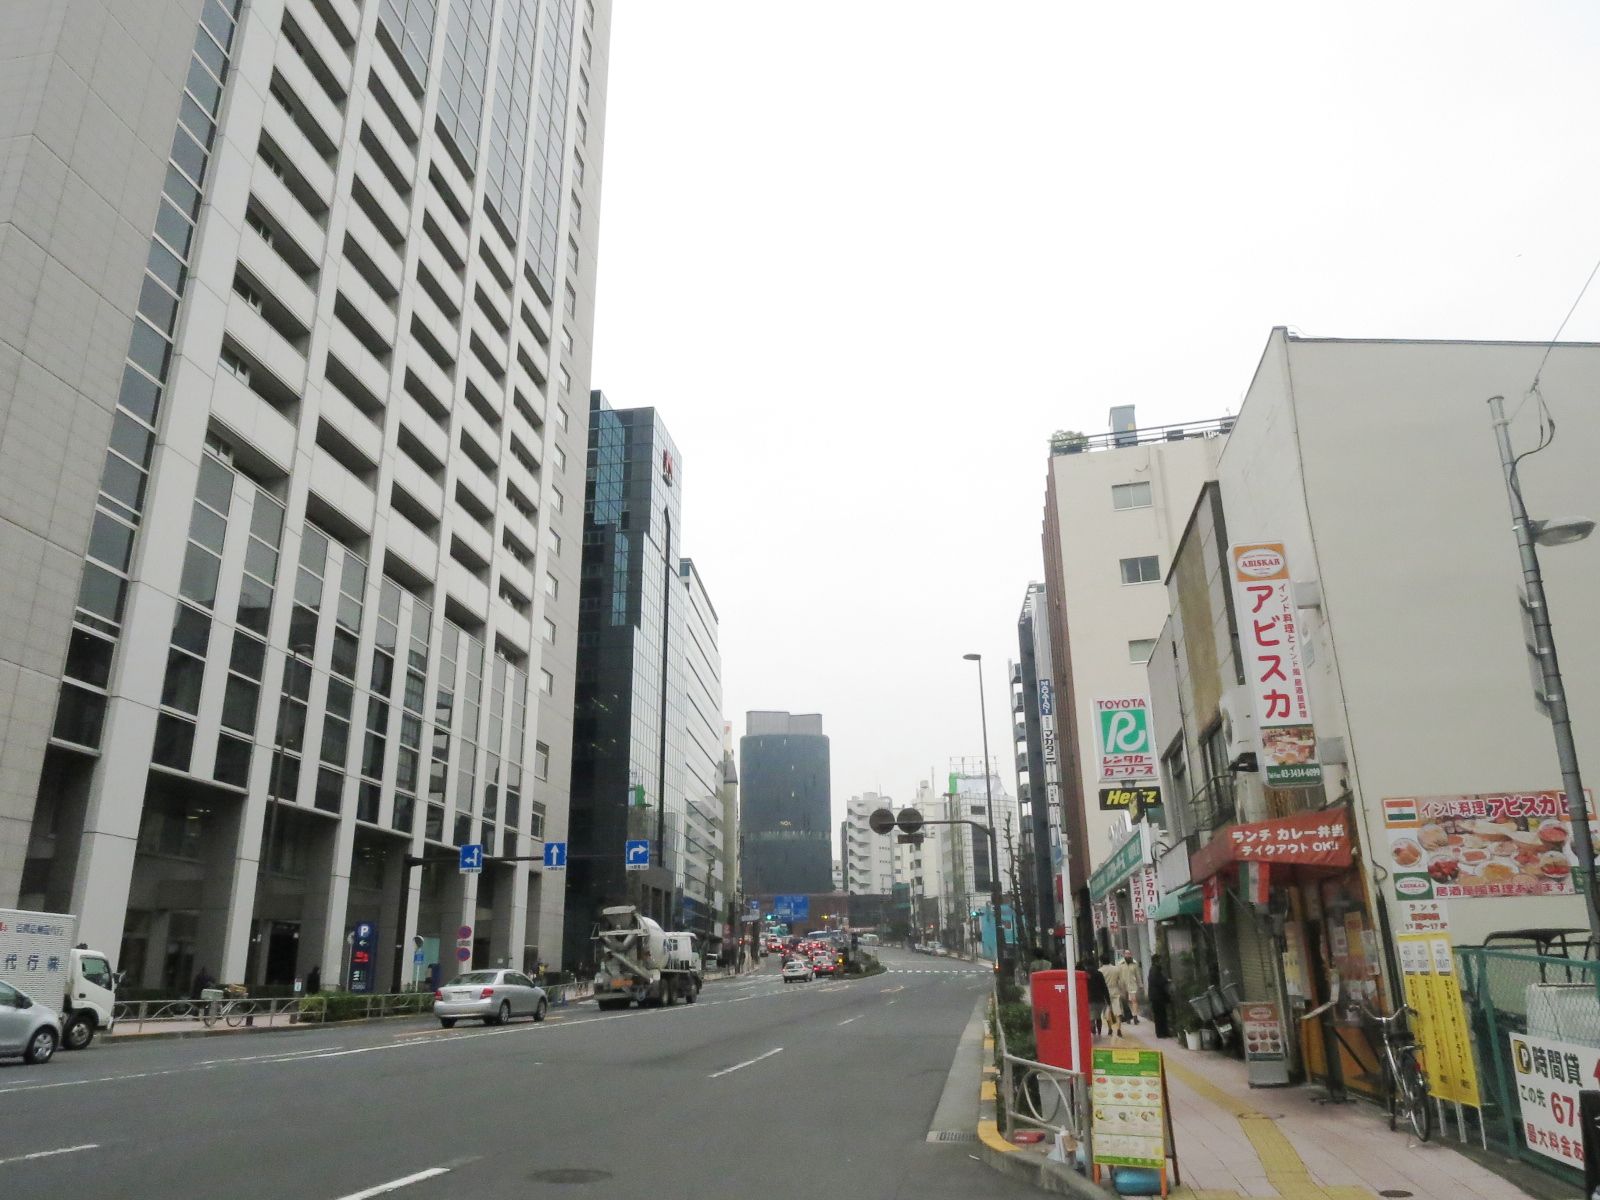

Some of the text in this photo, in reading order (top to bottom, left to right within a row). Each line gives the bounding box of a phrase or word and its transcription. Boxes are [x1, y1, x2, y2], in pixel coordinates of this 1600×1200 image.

[1246, 584, 1291, 719] アビスカ
[1097, 698, 1146, 709] TOYOTA
[1103, 754, 1152, 765] レンタカー
[1104, 767, 1153, 777] カーリース
[1106, 789, 1157, 806] Herz
[1420, 799, 1487, 817] インド料理
[1487, 795, 1556, 817] アビスカ
[1231, 824, 1345, 843] ランチ カレー弁当
[1145, 869, 1154, 903] レンタカー
[1532, 1046, 1584, 1088] 時間貸
[1520, 1084, 1581, 1128] この先 67
